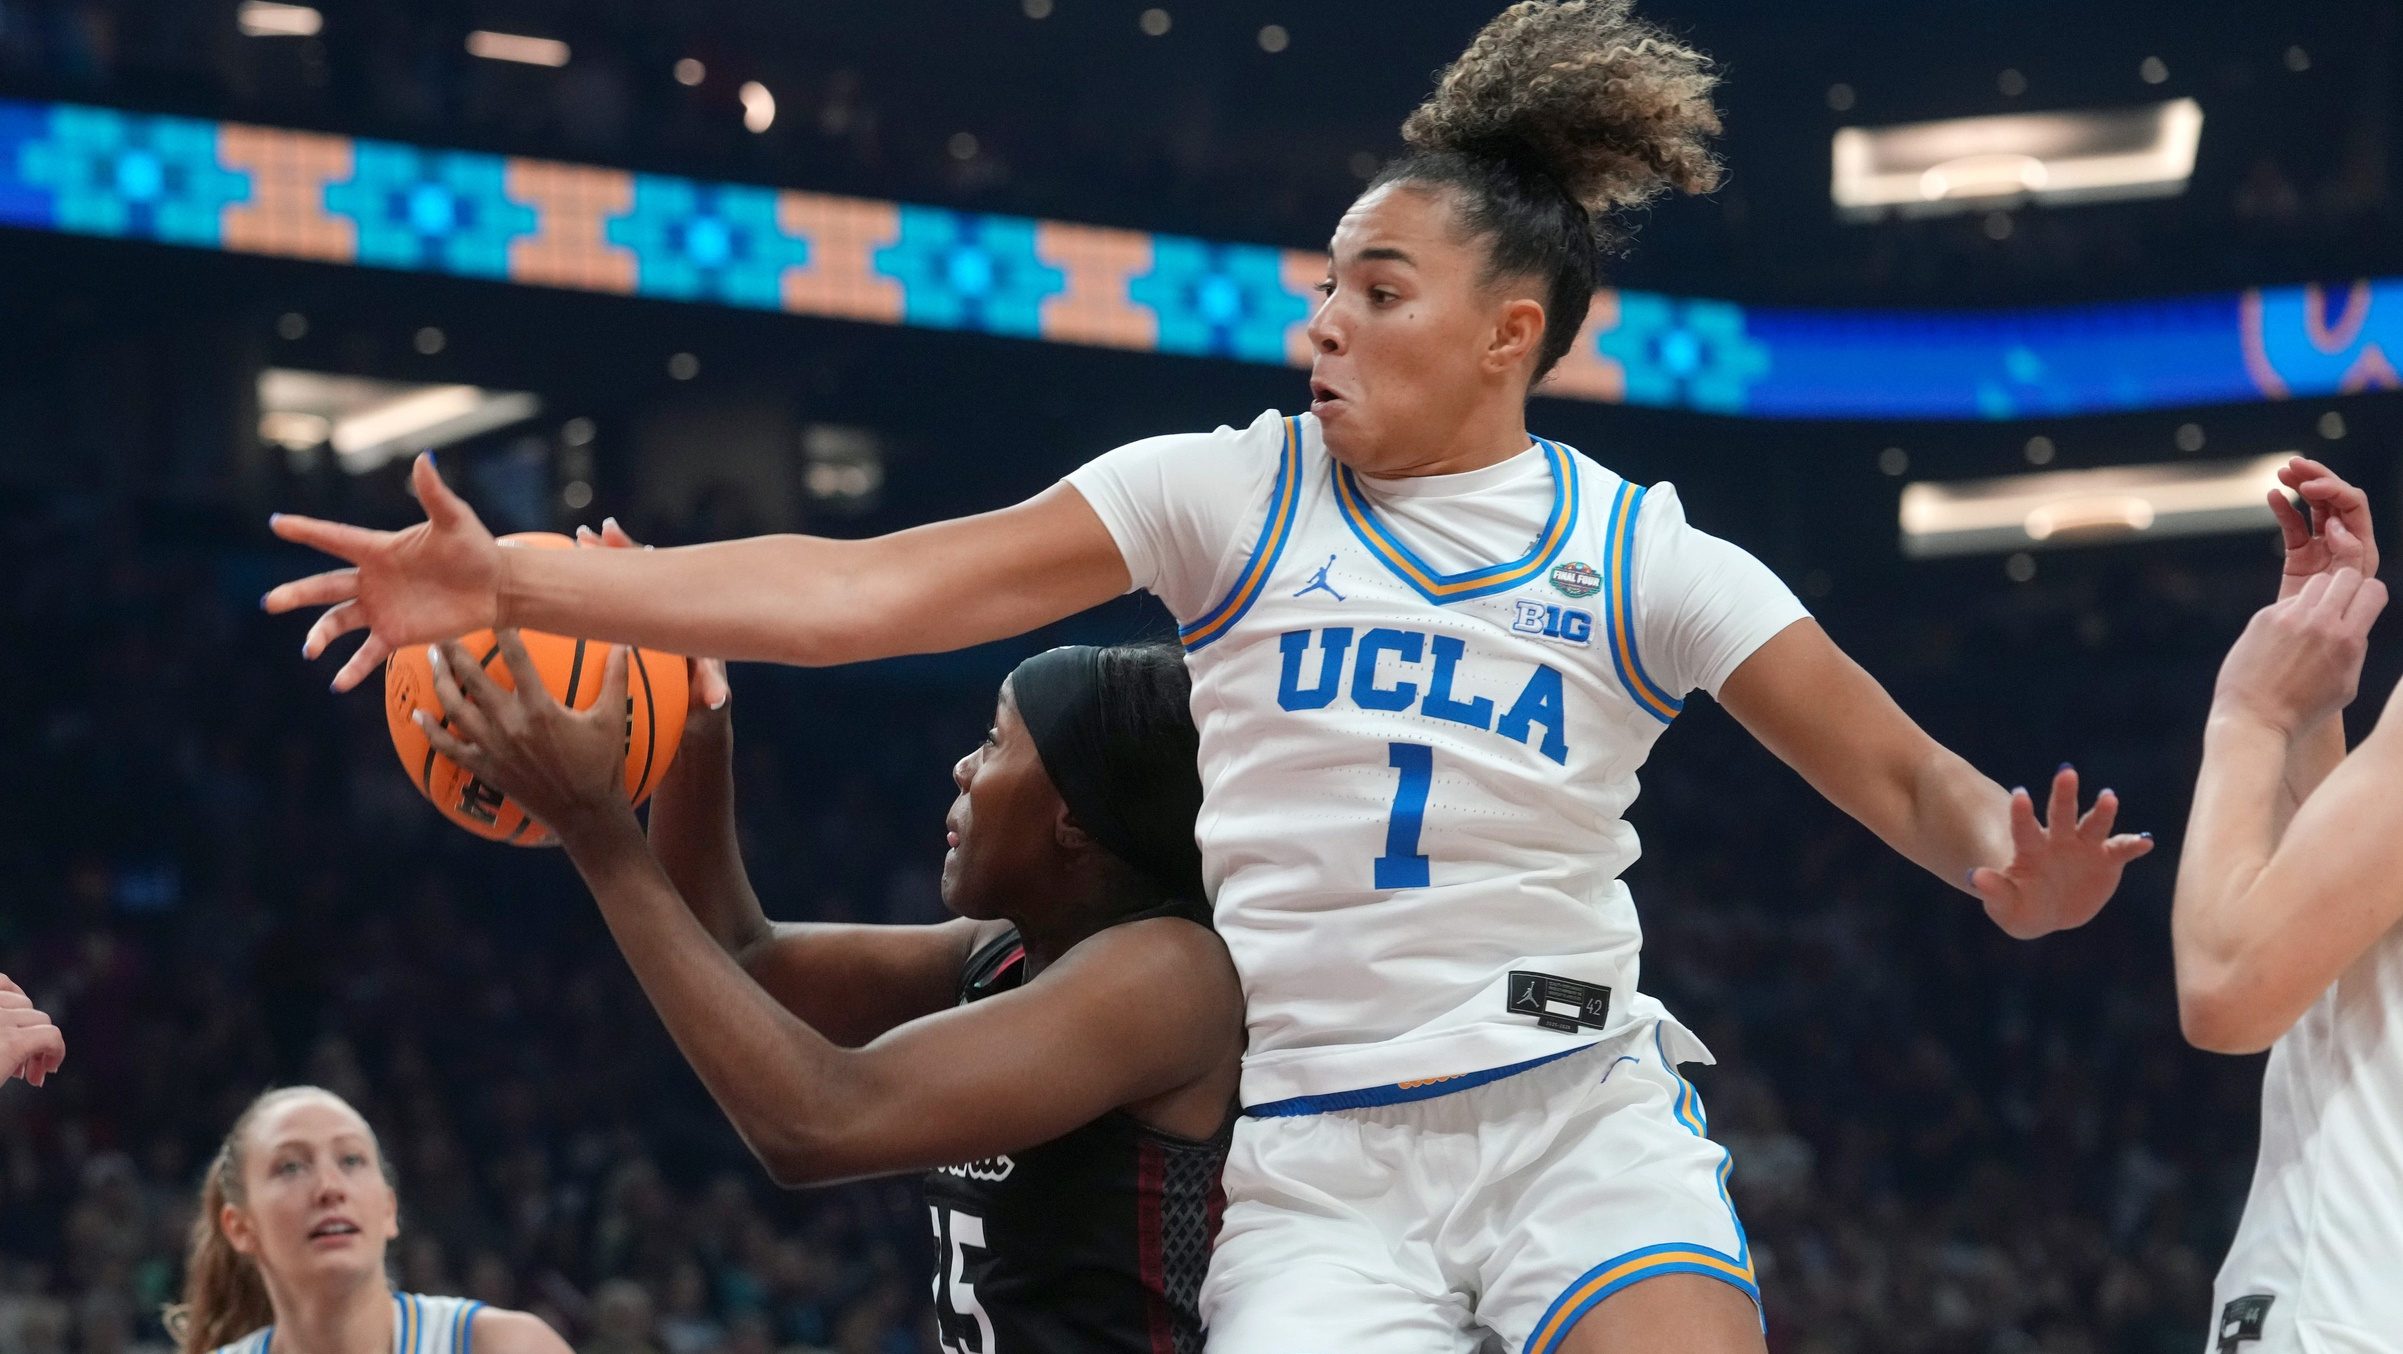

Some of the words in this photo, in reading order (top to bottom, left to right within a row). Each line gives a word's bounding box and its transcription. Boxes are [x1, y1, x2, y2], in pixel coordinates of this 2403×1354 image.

[1553, 570, 1576, 582] FINAL
[1577, 574, 1600, 587] FOUR
[1276, 626, 1569, 767] UCLA
[1373, 741, 1433, 890] 1
[1586, 998, 1602, 1016] 42
